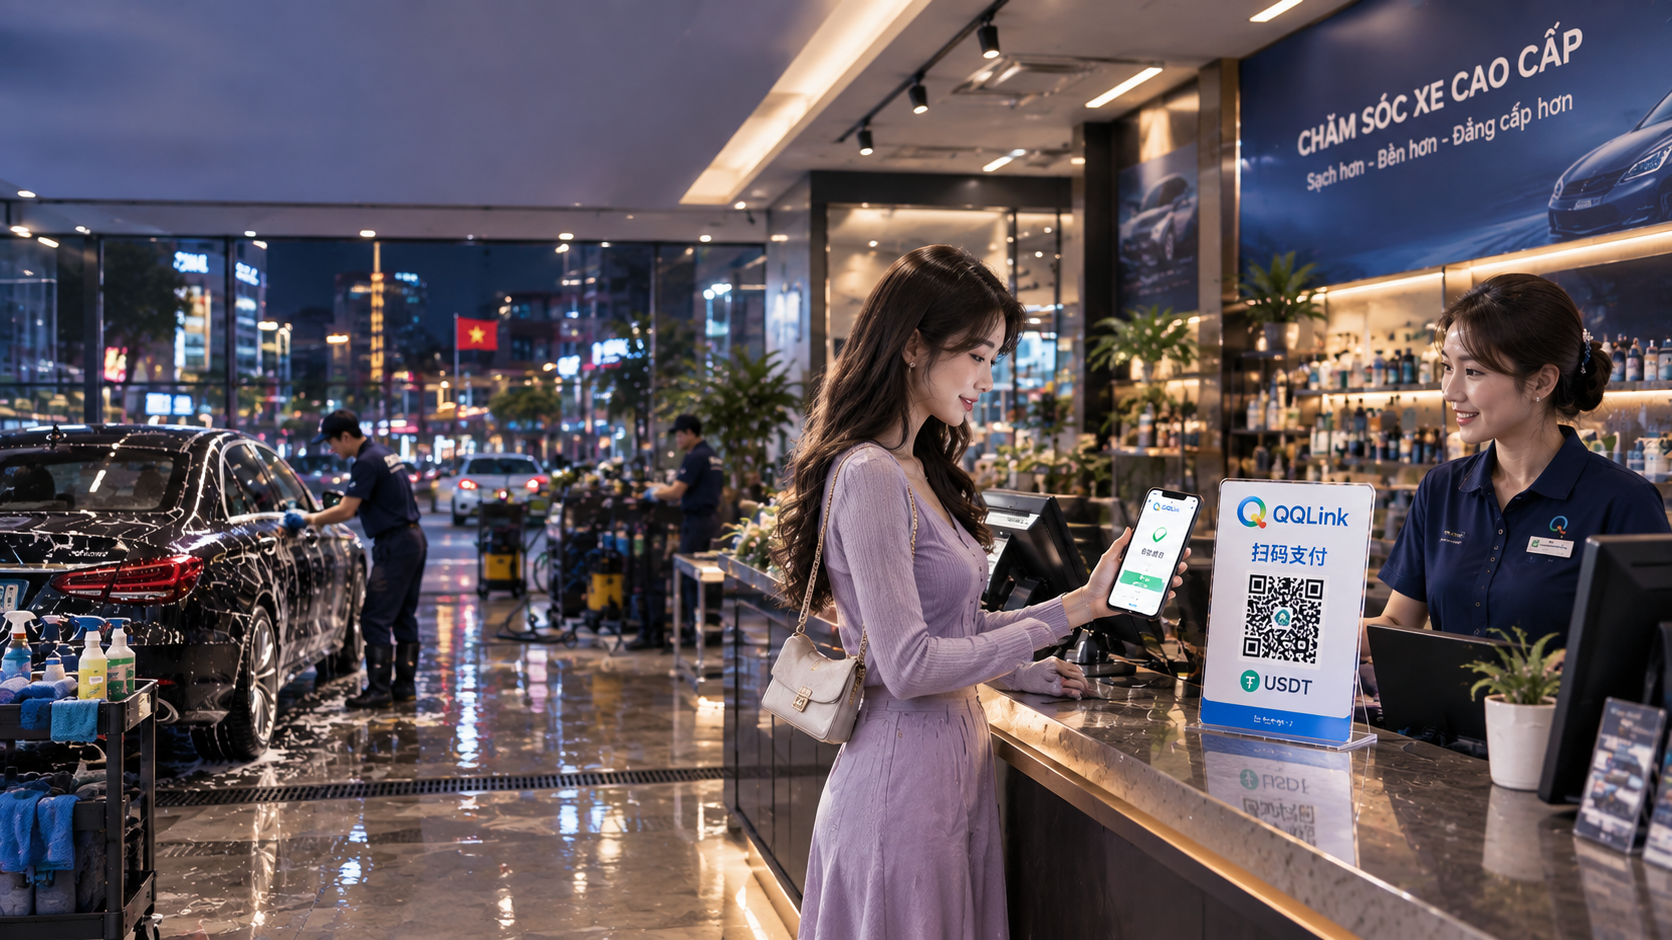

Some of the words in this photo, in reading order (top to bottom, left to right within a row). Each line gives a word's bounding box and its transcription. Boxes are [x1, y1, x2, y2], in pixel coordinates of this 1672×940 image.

[1297, 113, 1356, 157] CHĂM
[1361, 93, 1408, 135] SÓC
[1413, 79, 1445, 118] XE
[1451, 56, 1511, 103] CAO
[1517, 21, 1584, 79] CẤP
[1306, 166, 1338, 193] Sạch
[1339, 159, 1365, 181] hơn
[1377, 144, 1406, 170] Bền
[1408, 135, 1438, 160] hơn
[1452, 117, 1497, 147] Đẳng
[1499, 101, 1533, 132] cấp
[1537, 92, 1574, 121] hơn
[1273, 505, 1349, 527] QQLink
[1251, 542, 1328, 567] 扫码支付
[1264, 675, 1313, 695] USDT
